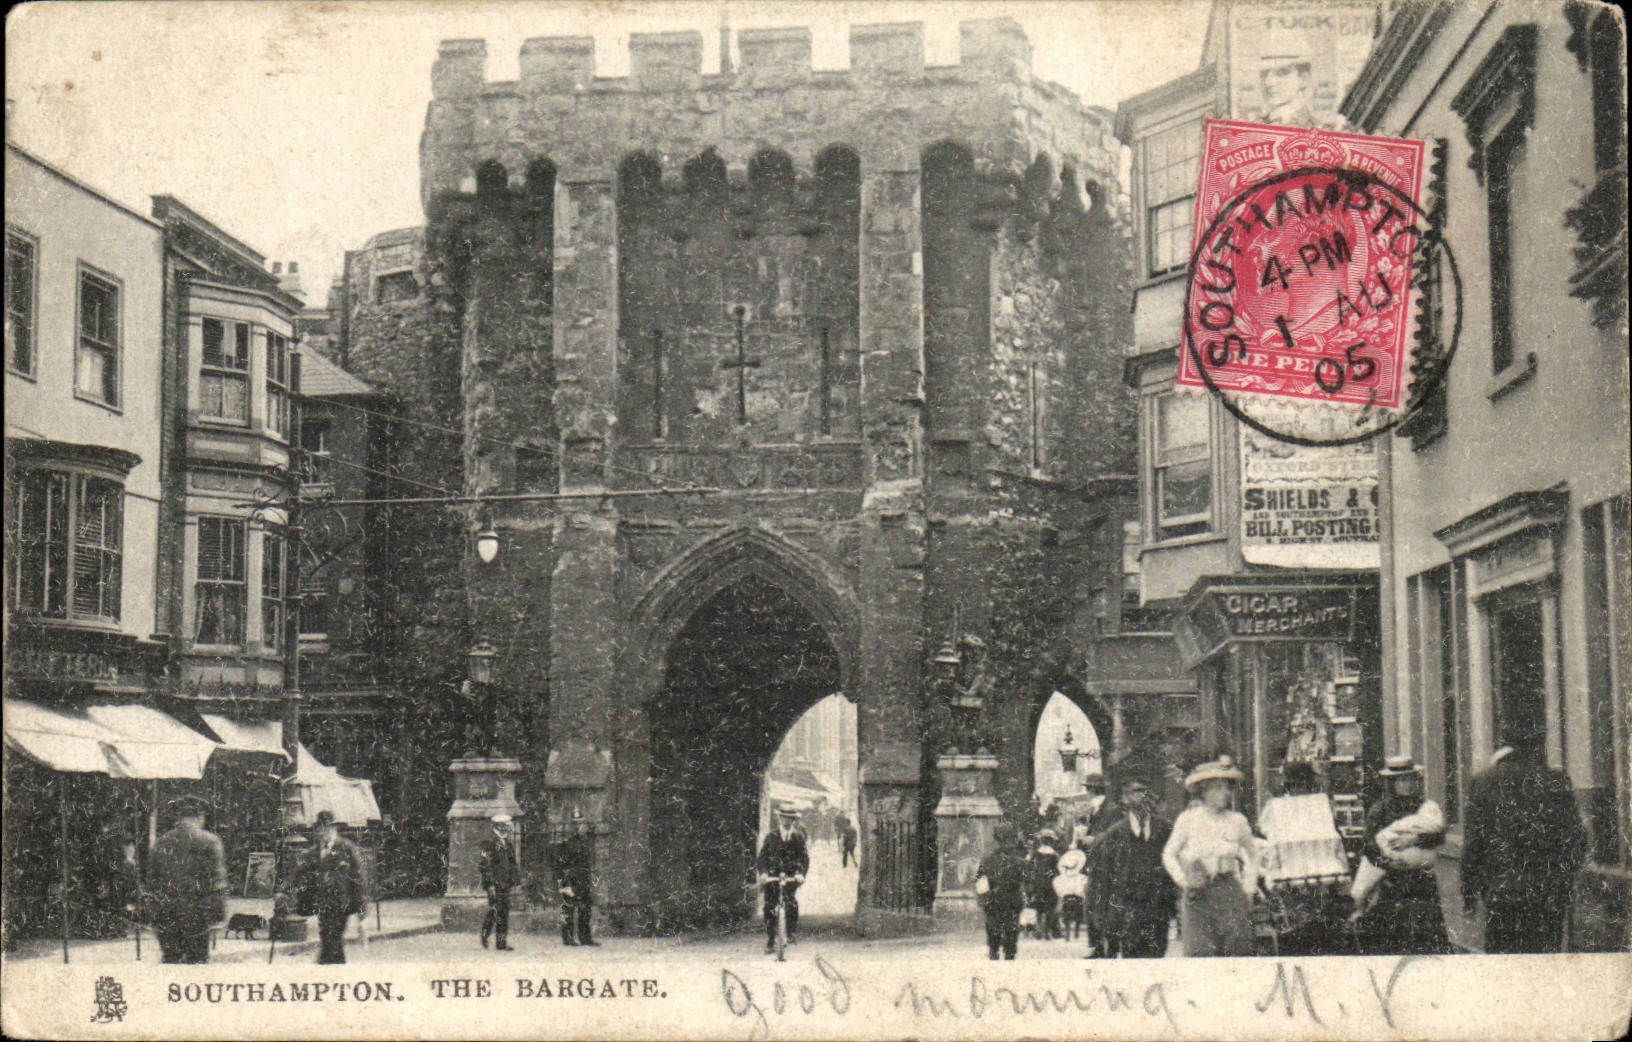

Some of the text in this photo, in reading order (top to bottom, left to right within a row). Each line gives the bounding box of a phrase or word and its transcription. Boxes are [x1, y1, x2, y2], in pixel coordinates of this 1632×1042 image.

[1218, 143, 1271, 172] POSTAGE
[1244, 487, 1330, 511] SHIELDS
[1346, 488, 1359, 508] &
[1245, 520, 1288, 538] BILL
[1292, 517, 1371, 537] POSTING
